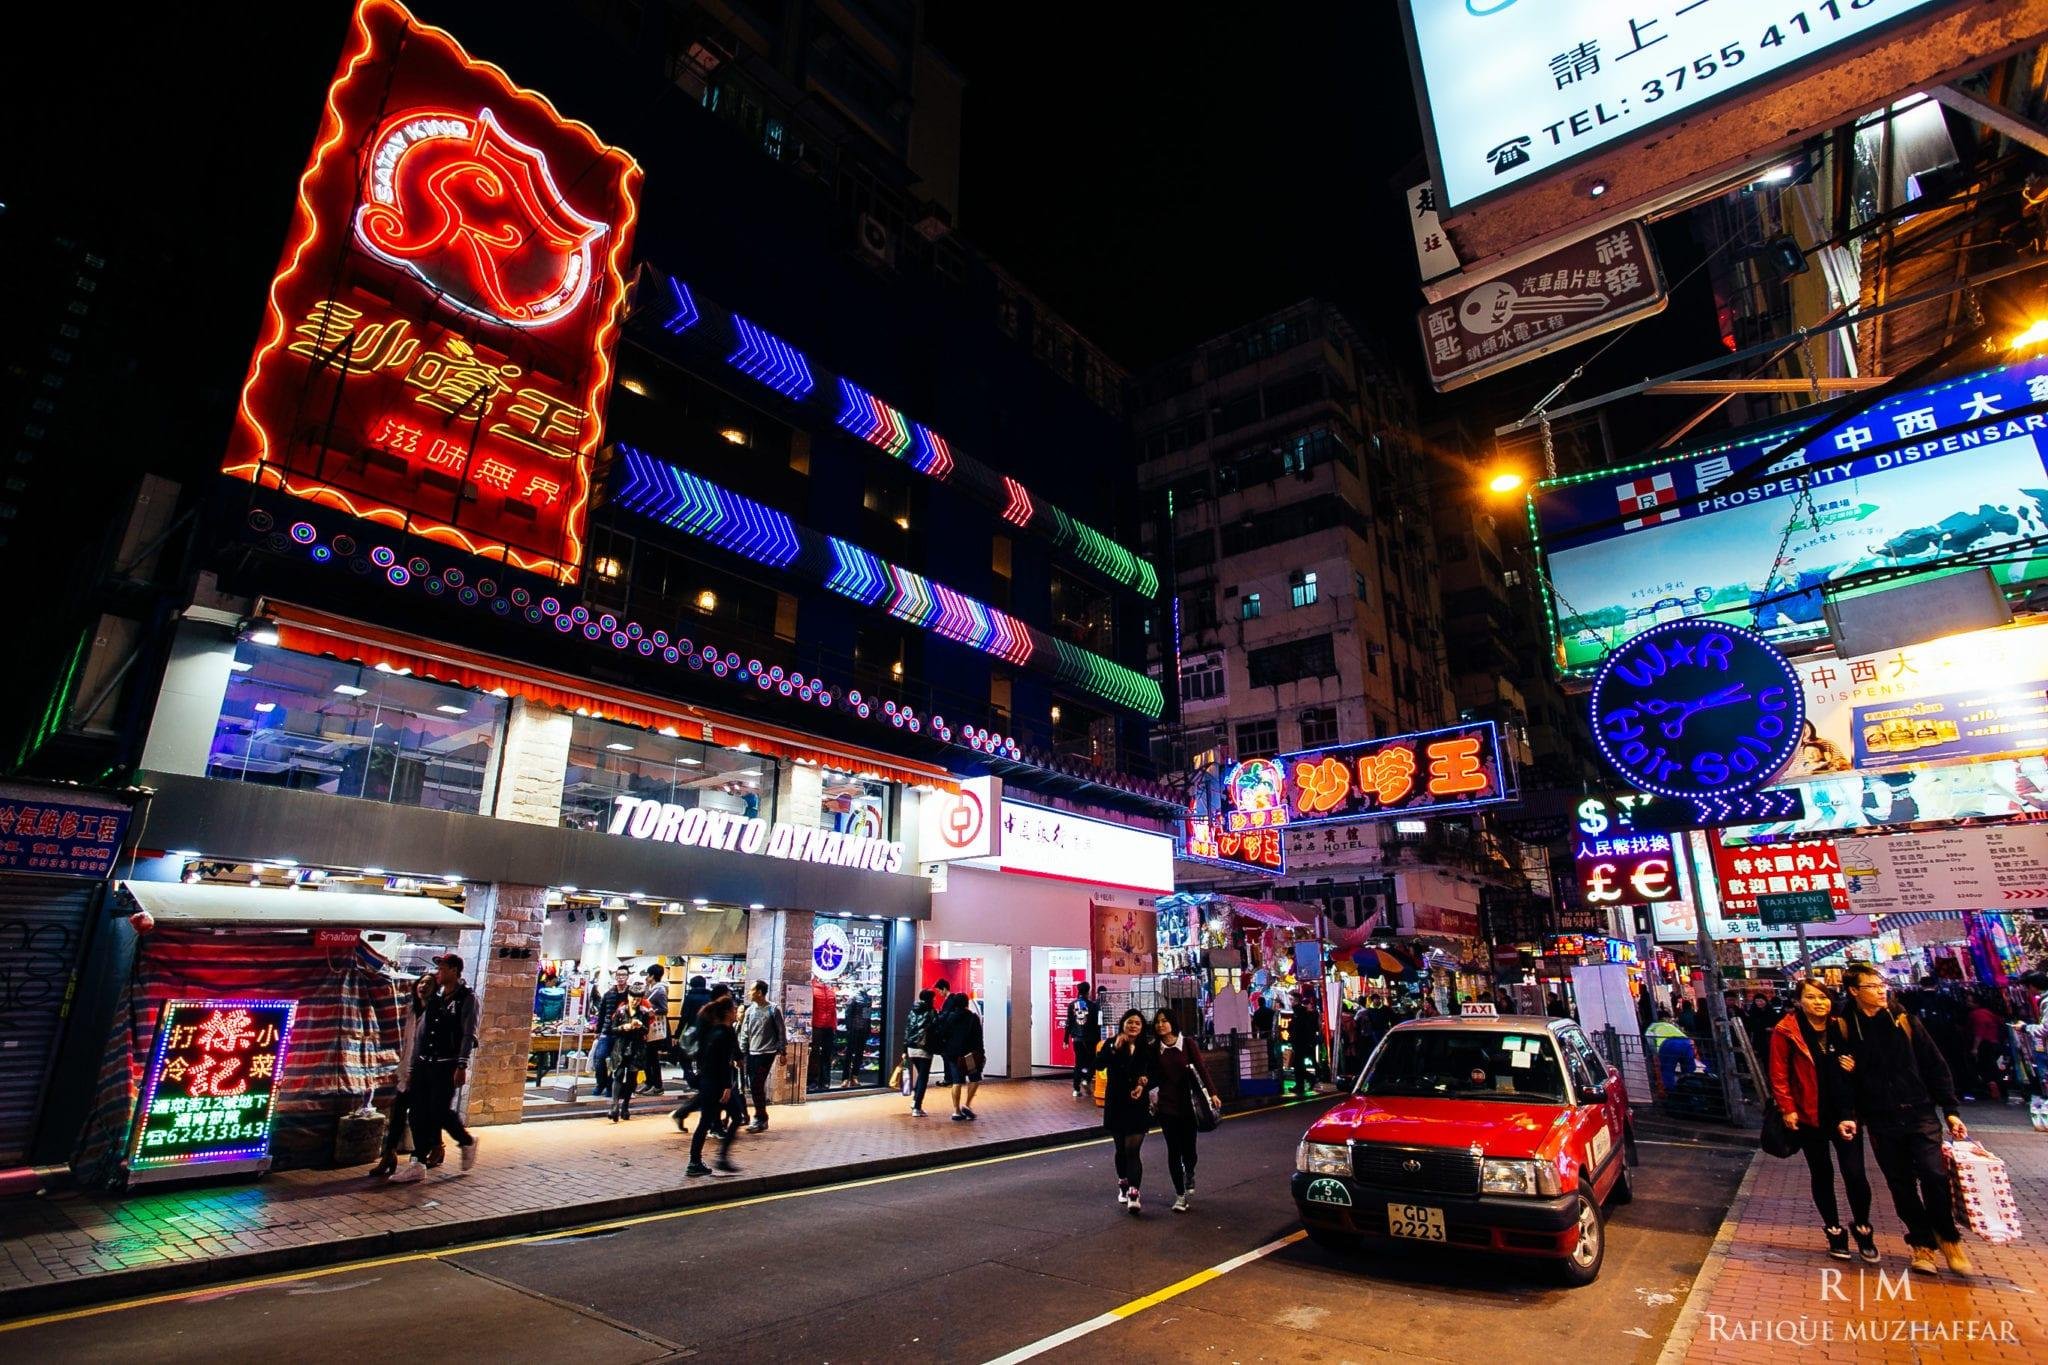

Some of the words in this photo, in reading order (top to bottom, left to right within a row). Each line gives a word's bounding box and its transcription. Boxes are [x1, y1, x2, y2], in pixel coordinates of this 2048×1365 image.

[1542, 96, 1632, 146] TEL:
[1641, 41, 1746, 104] 3755
[374, 136, 408, 204] SATAY
[404, 120, 469, 142] KING
[1596, 230, 1642, 297] 祥發
[1522, 269, 1602, 294] 汽車晶片匙
[1491, 290, 1511, 325] KEY
[1428, 306, 1463, 364] 配匙
[1875, 414, 2048, 470] DISPENSAR
[376, 420, 561, 504] 滋味無界
[1603, 708, 1683, 782] Hair
[1691, 686, 1789, 785] Salon
[607, 795, 768, 855] TORONTO
[764, 822, 906, 873] DYNAMICS
[1323, 840, 1366, 852] HOTEL
[1577, 834, 1670, 859] 人民幣找換
[1763, 898, 1787, 907] TAXI
[1789, 895, 1824, 904] STAND
[1773, 908, 1821, 919] 的士站
[320, 931, 358, 943] SmarTone
[1463, 1004, 1492, 1015] TAXI
[166, 1120, 266, 1145] 62433843
[1315, 1180, 1341, 1189] TAXI
[1324, 1185, 1333, 1197] 5
[1403, 1205, 1428, 1223] GD
[1391, 1220, 1444, 1241] 2223
